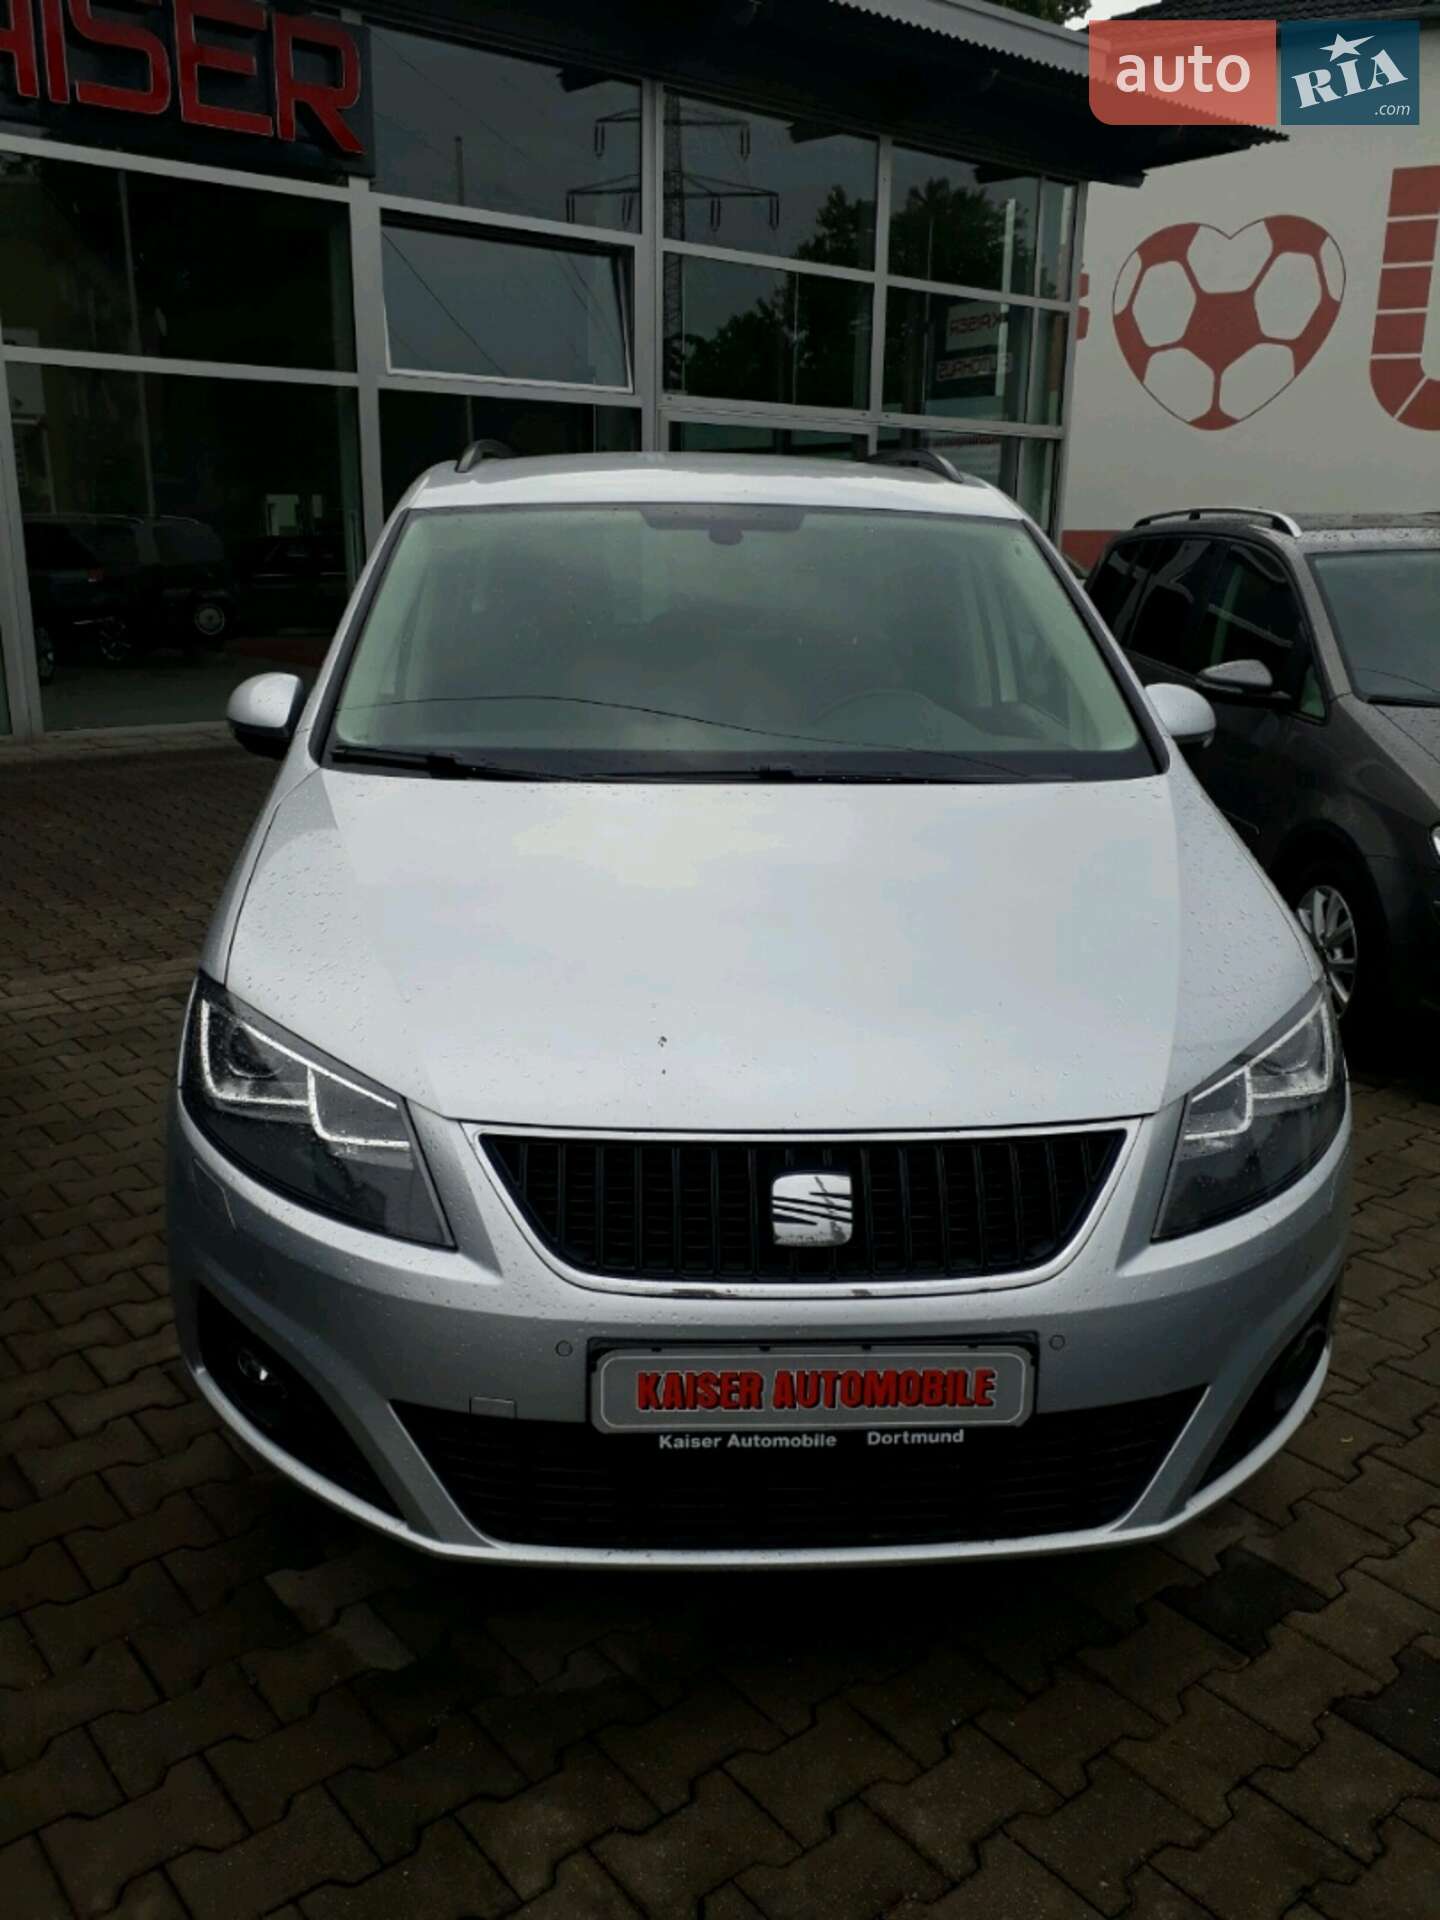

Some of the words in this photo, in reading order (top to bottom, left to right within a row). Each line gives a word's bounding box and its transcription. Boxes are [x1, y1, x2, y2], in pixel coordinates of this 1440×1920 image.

[636, 1370, 765, 1411] KAISER
[772, 1367, 997, 1410] AUTOMOBILE
[659, 1433, 722, 1449] Kaiser
[727, 1433, 837, 1448] Automobile
[867, 1429, 965, 1446] Dortmund
